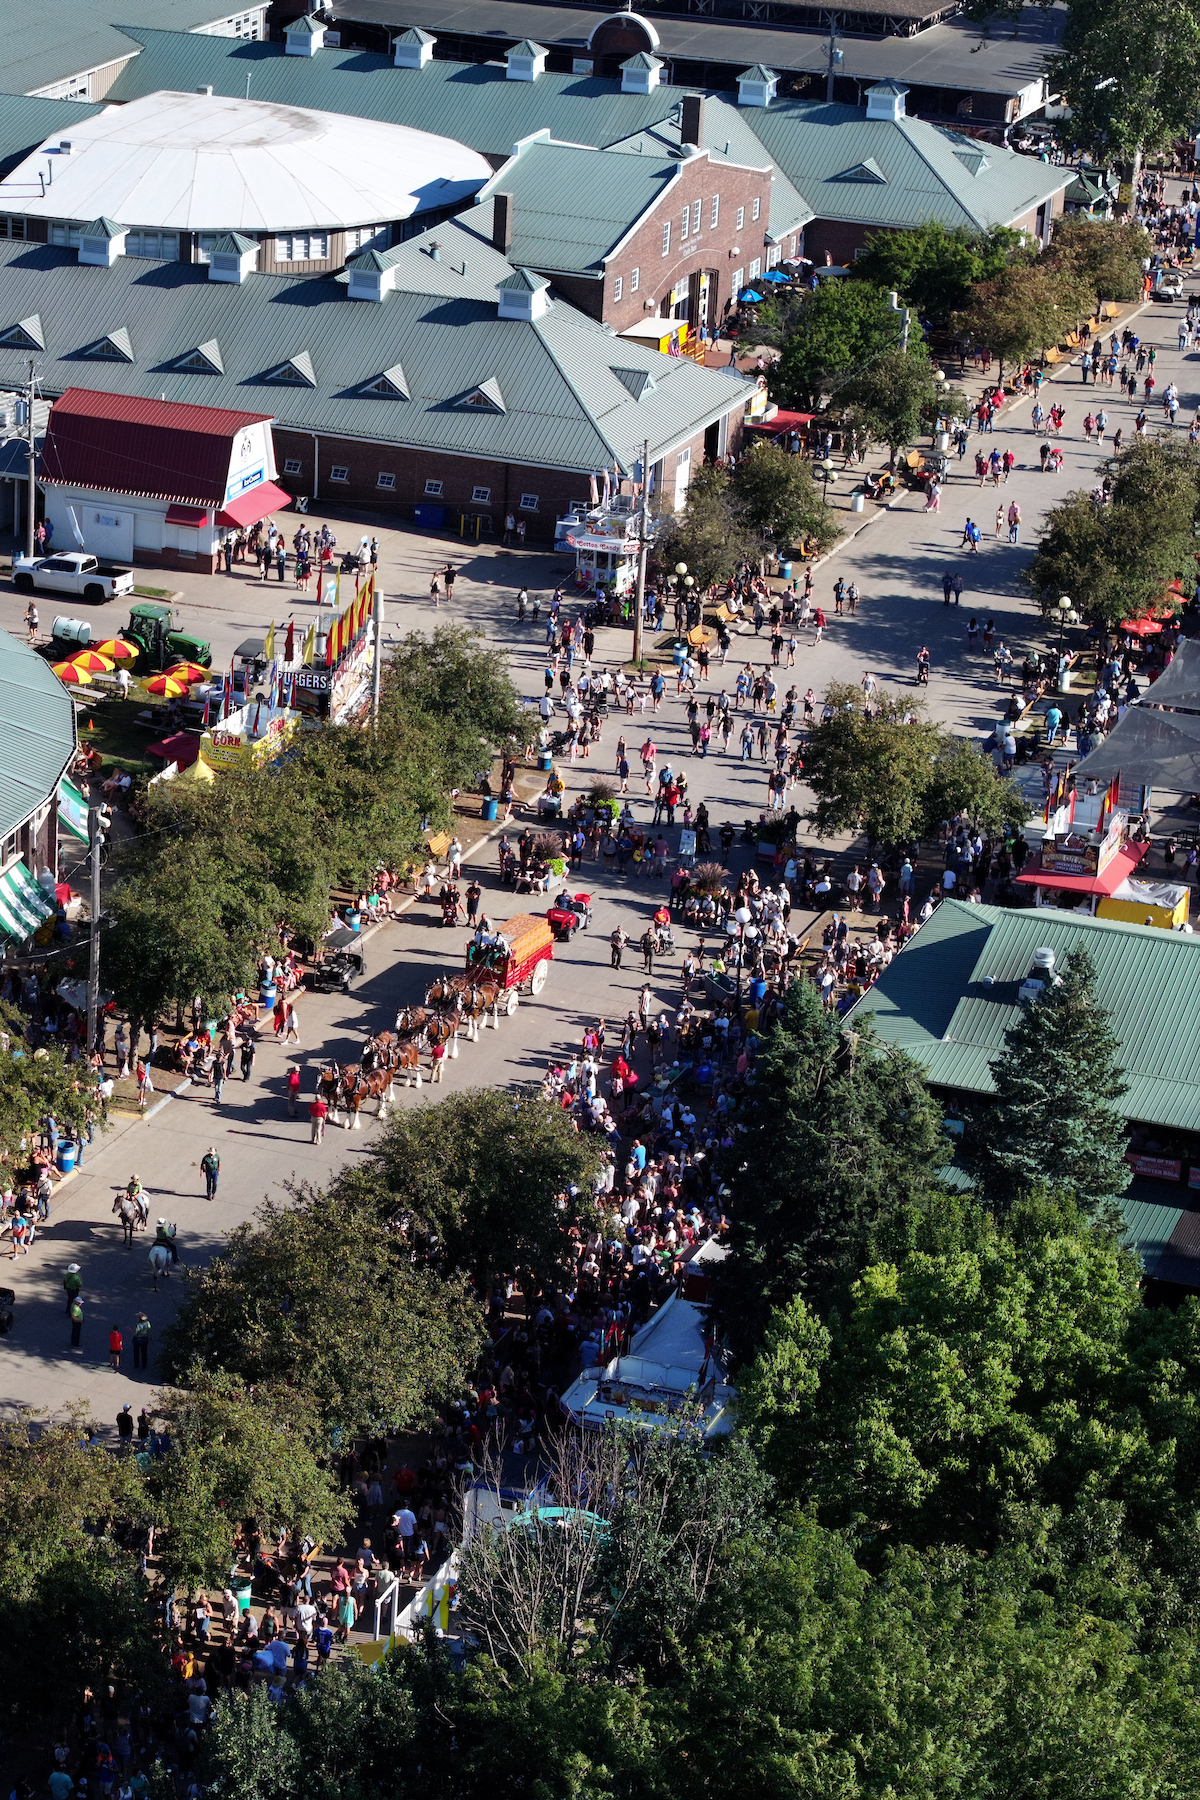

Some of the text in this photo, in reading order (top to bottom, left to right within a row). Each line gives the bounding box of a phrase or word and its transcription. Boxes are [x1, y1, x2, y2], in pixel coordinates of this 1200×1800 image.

[577, 540, 598, 548] Cotton
[600, 543, 620, 552] Candy
[278, 671, 327, 690] BURGERS
[213, 731, 241, 747] CORN
[1136, 1165, 1163, 1175] LOBSTER
